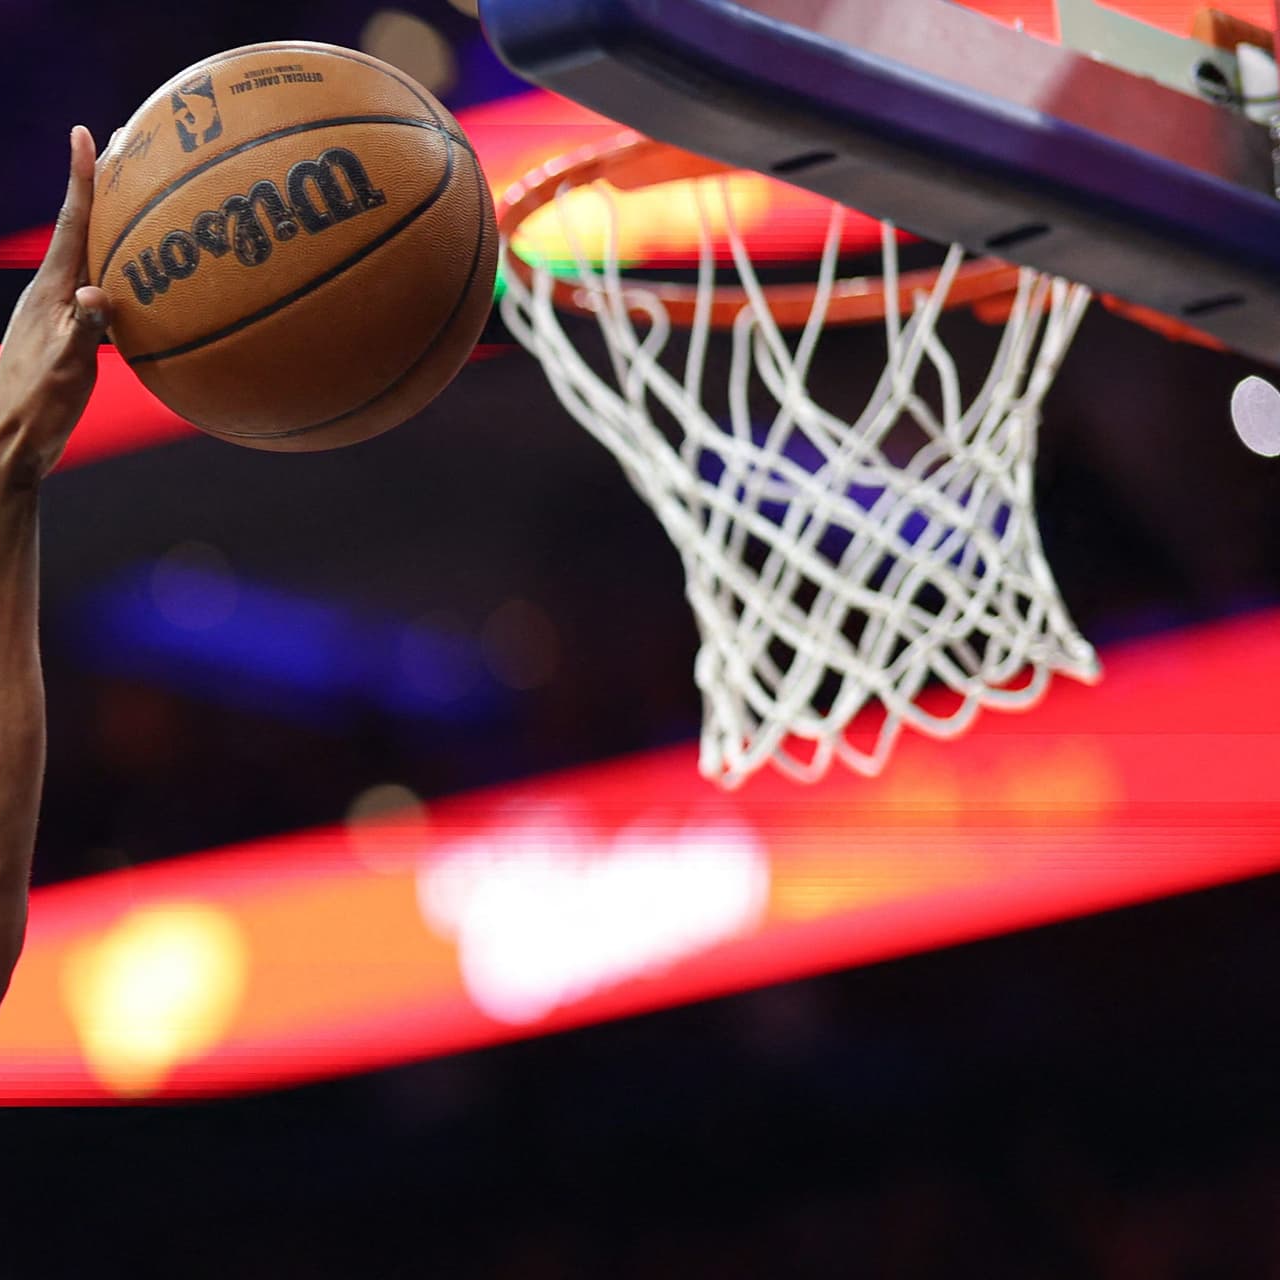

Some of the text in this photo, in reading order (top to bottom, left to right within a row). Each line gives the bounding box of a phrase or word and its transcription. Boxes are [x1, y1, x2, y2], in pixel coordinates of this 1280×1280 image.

[229, 72, 324, 95] OFFICIAL GAME BALL
[120, 146, 387, 306] Wilson
